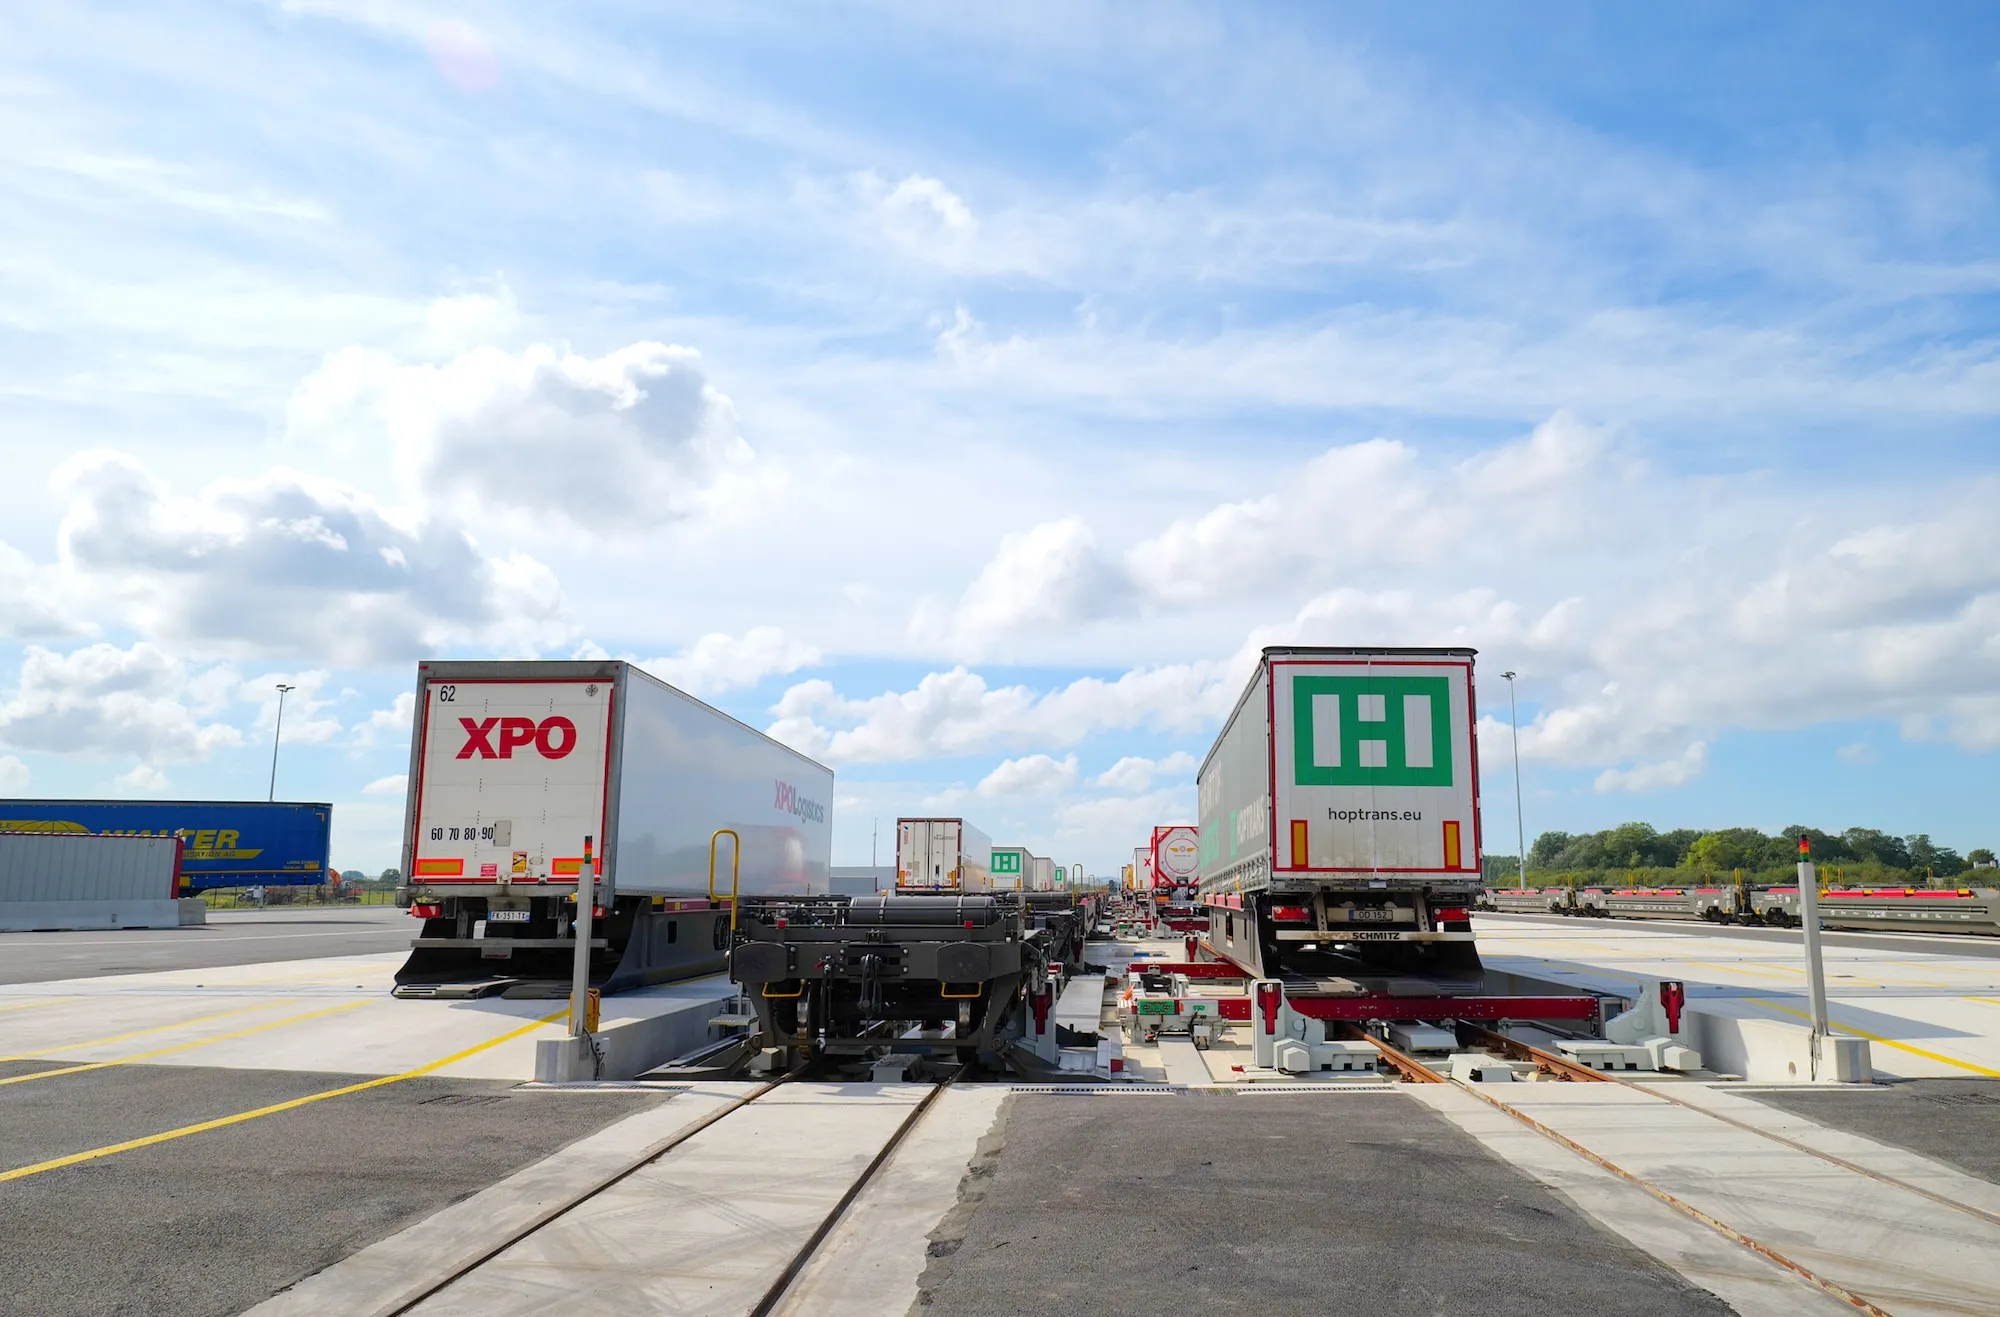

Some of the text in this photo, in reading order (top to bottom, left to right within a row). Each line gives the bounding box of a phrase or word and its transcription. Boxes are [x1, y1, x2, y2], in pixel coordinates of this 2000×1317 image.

[440, 685, 456, 702] 62
[455, 716, 577, 760] XPO
[1328, 808, 1422, 823] hoptrans.eu
[431, 826, 494, 841] 60 70 80 90
[1373, 911, 1387, 919] 152
[1352, 932, 1400, 940] SCHMITZ
